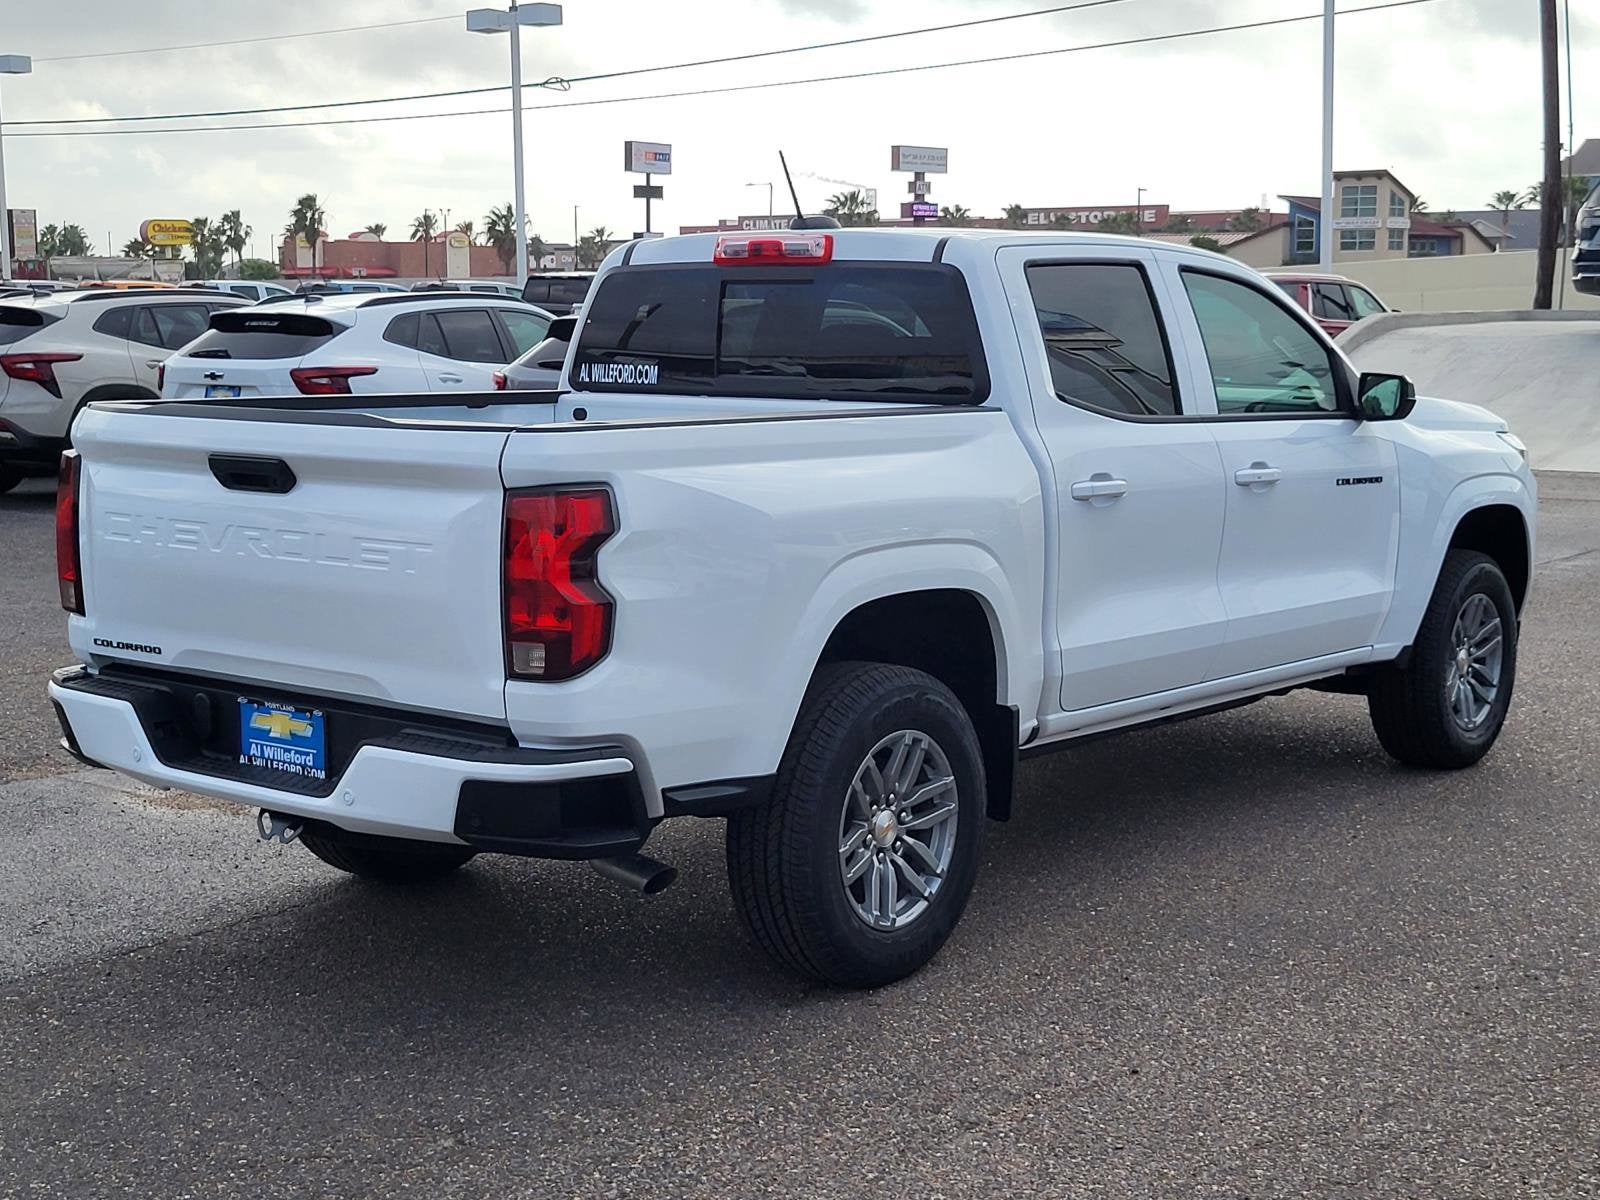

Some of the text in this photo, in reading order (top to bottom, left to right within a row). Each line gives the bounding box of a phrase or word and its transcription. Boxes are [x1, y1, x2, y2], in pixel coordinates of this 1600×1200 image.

[742, 219, 789, 230] CLIMATE
[579, 362, 658, 384] AL WILLEFORD.COM
[1336, 476, 1383, 486] COLORADO
[104, 510, 433, 574] CHEVROLET
[93, 638, 162, 655] COLORADO
[264, 701, 295, 712] PORTLAND
[249, 743, 314, 766] Al Willeford
[239, 754, 326, 779] AL WILLEFORDCOM
